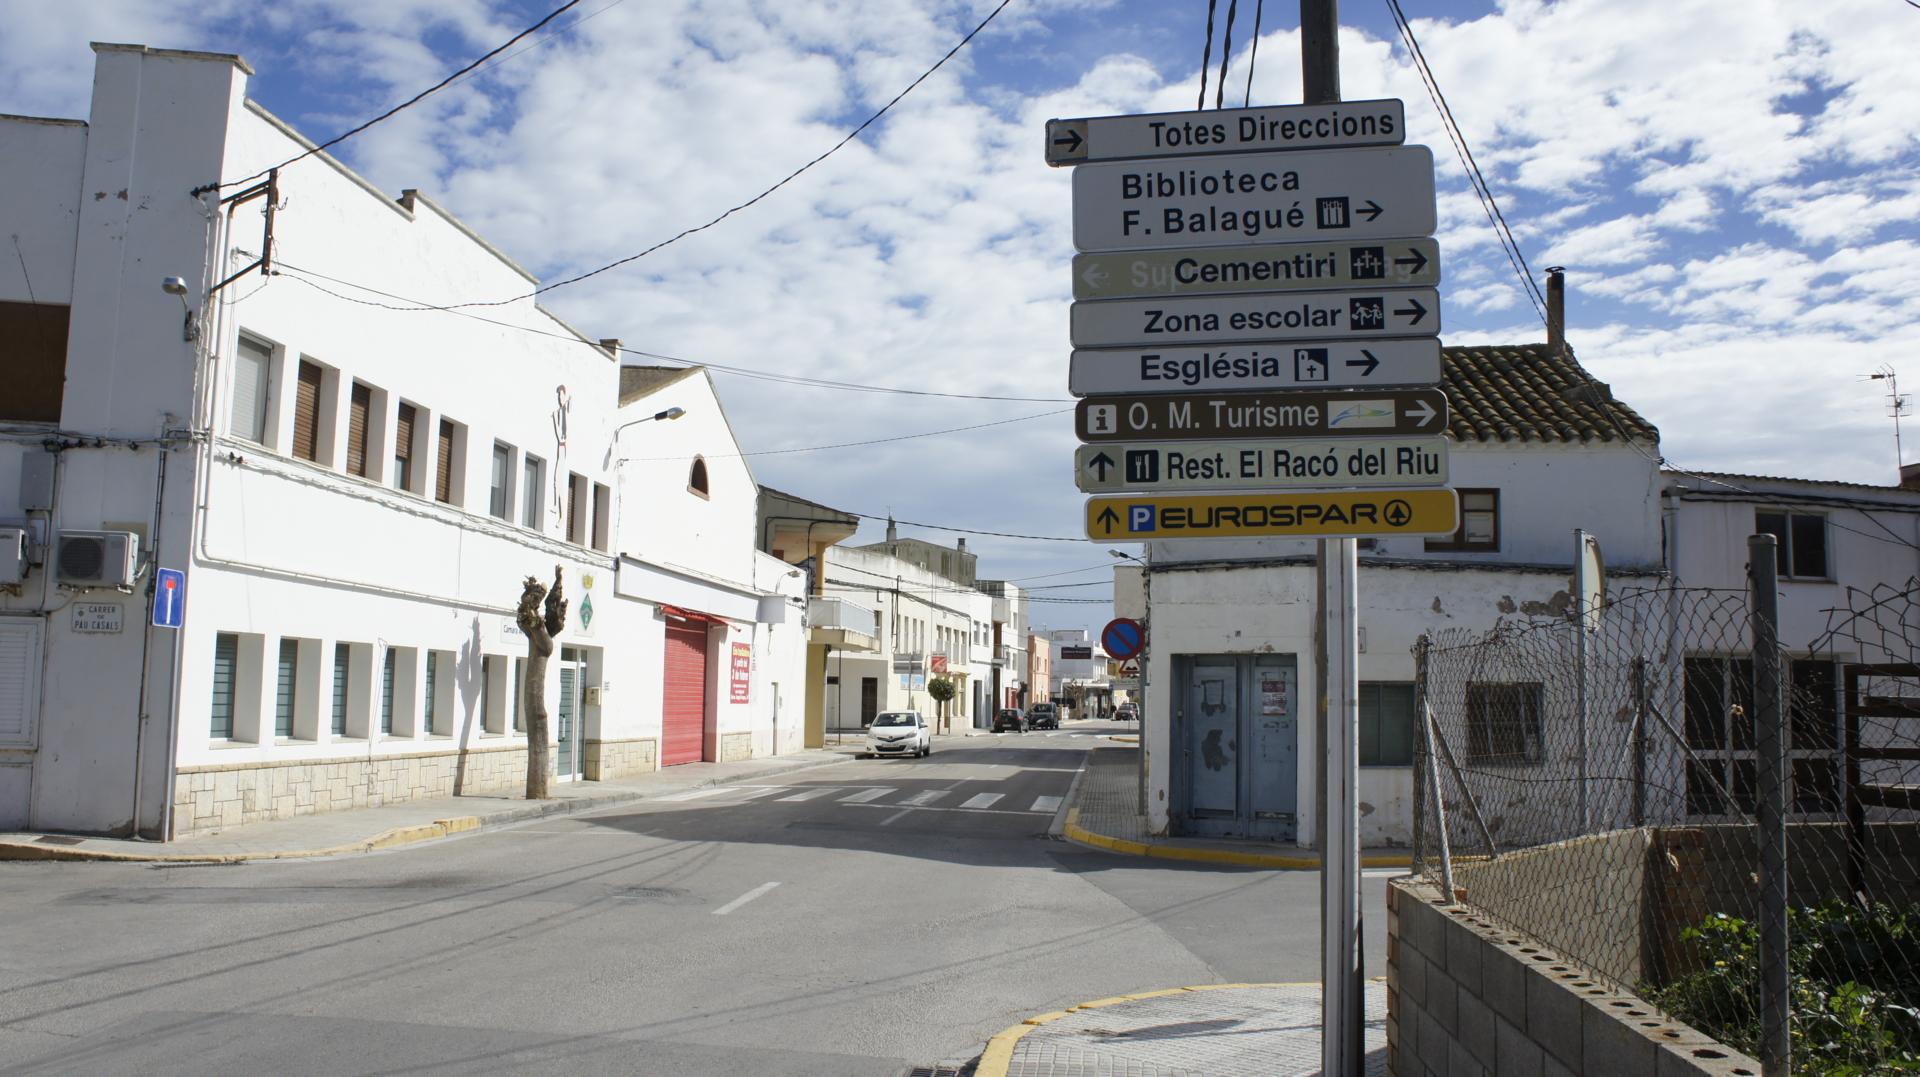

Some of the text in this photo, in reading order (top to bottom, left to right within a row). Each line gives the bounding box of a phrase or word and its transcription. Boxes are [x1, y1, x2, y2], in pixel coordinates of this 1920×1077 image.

[1149, 111, 1395, 147] Totes Direccions
[1122, 169, 1301, 199] Biblioteca
[1122, 201, 1305, 236] F. Balagué
[1174, 252, 1337, 284] Cementiri
[1143, 304, 1342, 334] Zona escolar
[1140, 352, 1280, 386] Església
[1128, 402, 1157, 430] O.
[1168, 402, 1200, 429] M.
[1209, 400, 1320, 428] Turisme
[1167, 446, 1440, 480] Rest. El Racó del Riu
[1160, 503, 1378, 529] EUROSPAR
